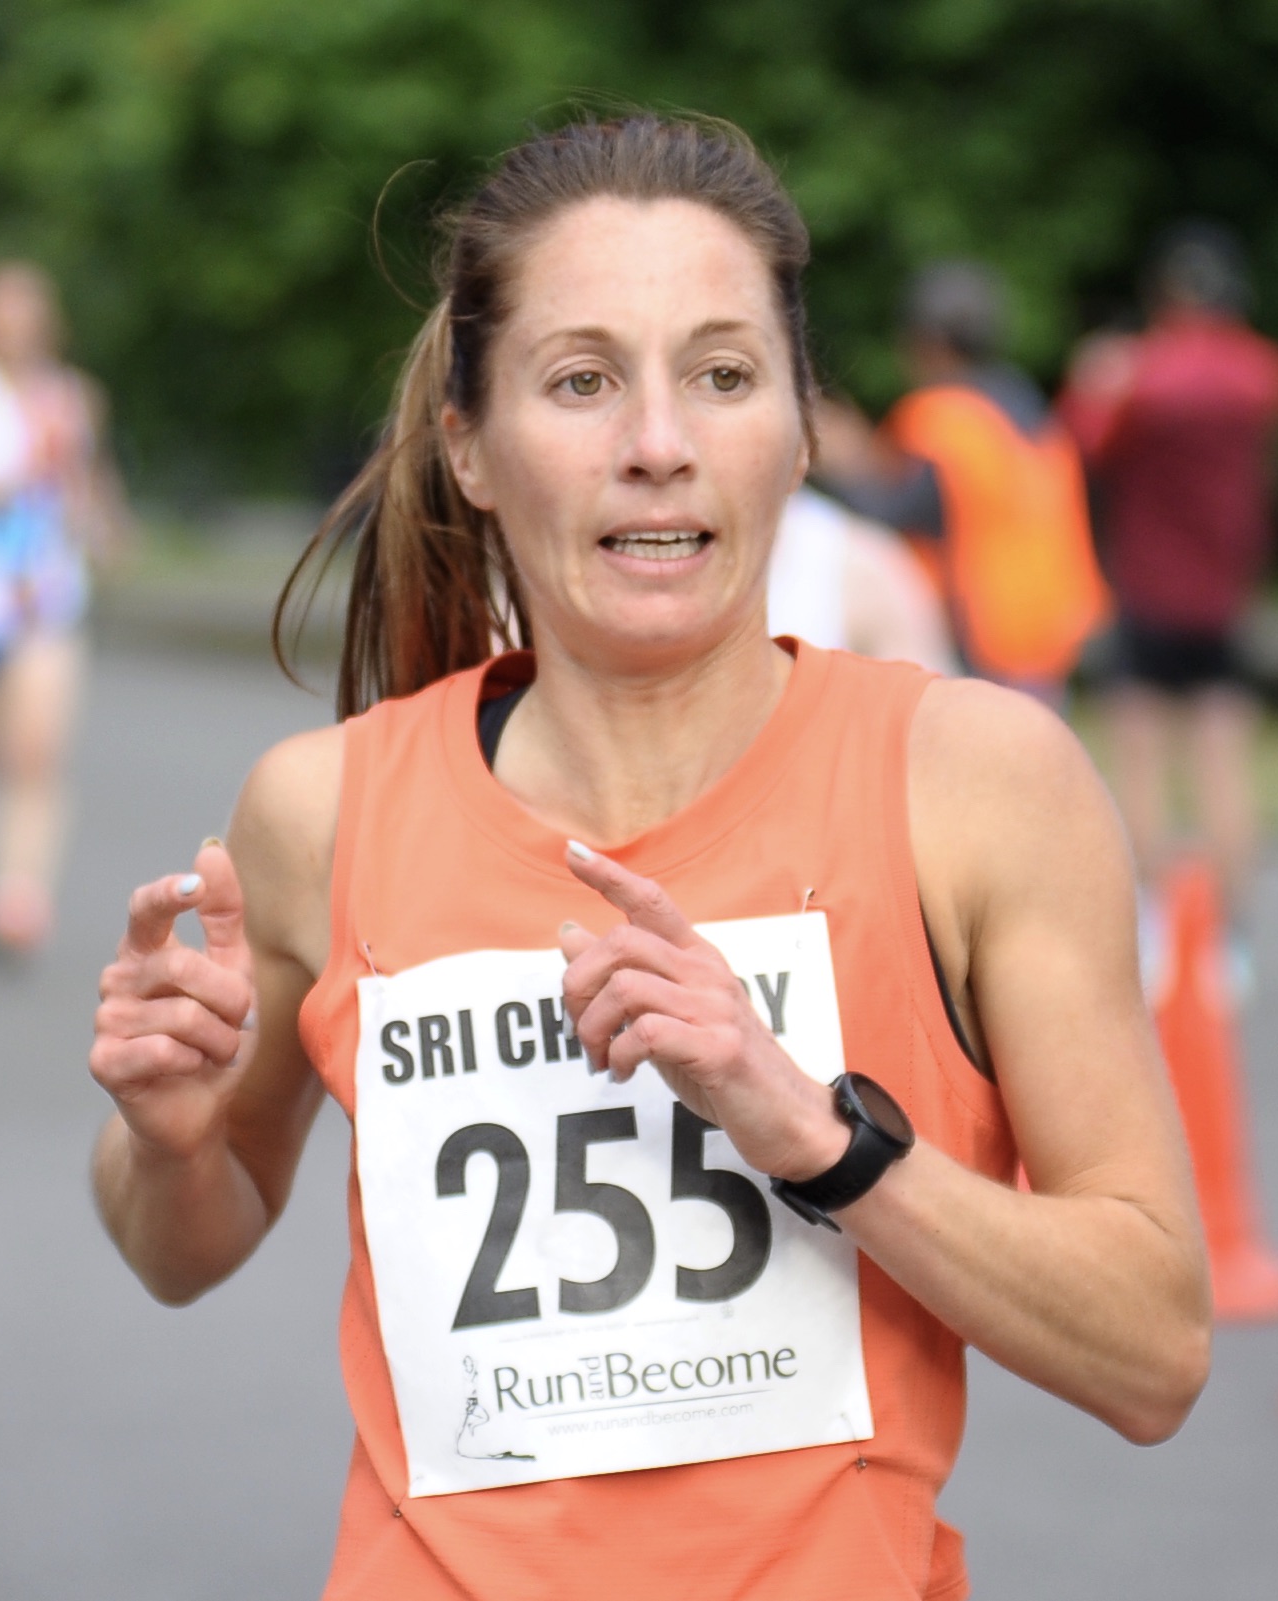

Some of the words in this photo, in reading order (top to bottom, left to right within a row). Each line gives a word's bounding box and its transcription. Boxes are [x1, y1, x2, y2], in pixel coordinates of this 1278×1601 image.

[380, 1008, 478, 1086] SRI
[434, 1101, 772, 1333] 255
[493, 1366, 586, 1413] Run
[604, 1346, 798, 1400] Become
[546, 1401, 754, 1437] www.runandbecome.com
